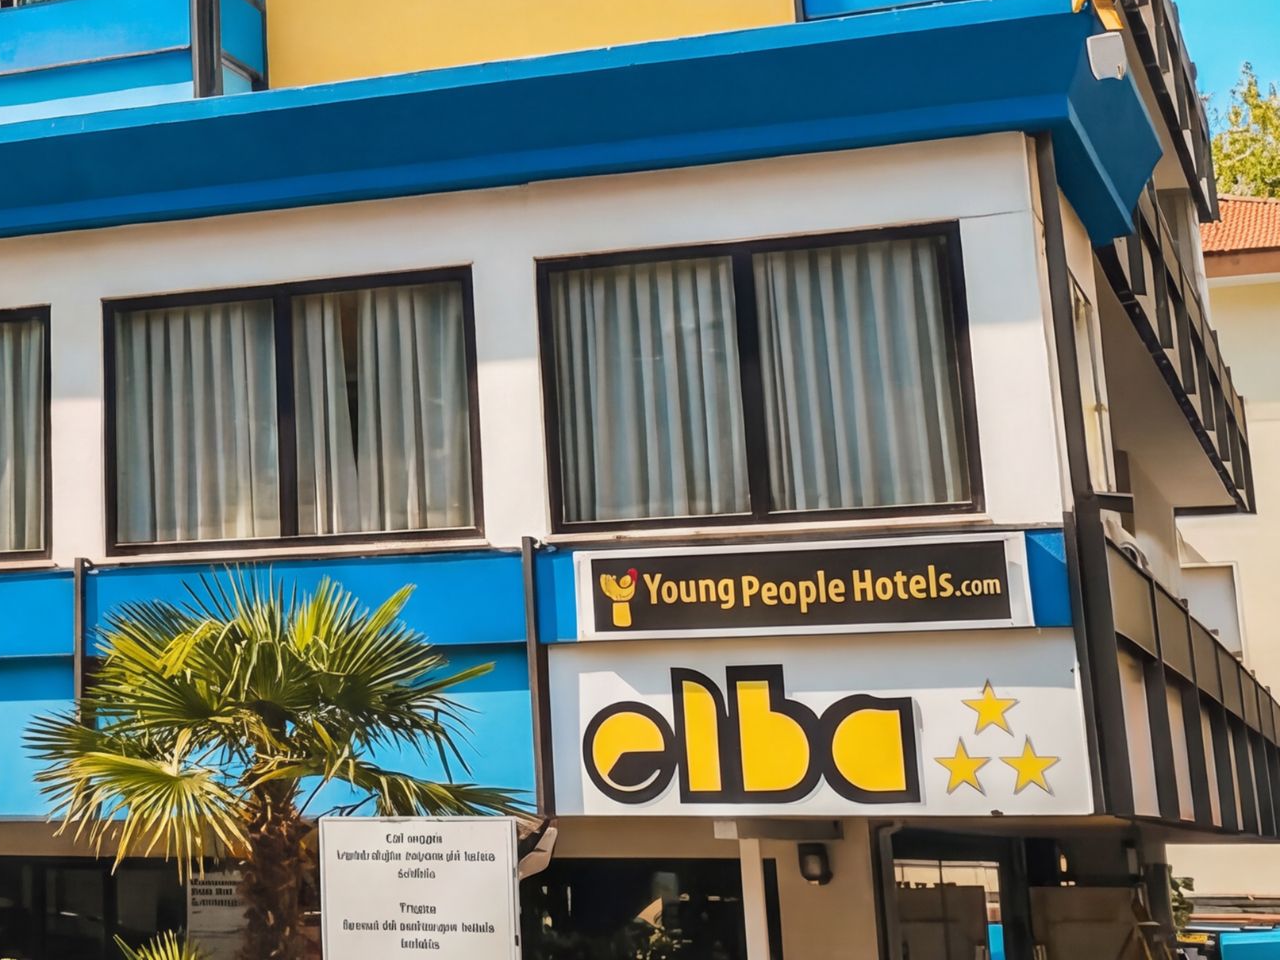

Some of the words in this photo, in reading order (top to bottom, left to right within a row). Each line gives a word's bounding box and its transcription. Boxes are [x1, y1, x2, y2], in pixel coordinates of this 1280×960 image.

[642, 572, 736, 609] Young
[742, 570, 846, 613] People
[582, 664, 922, 804] elba
